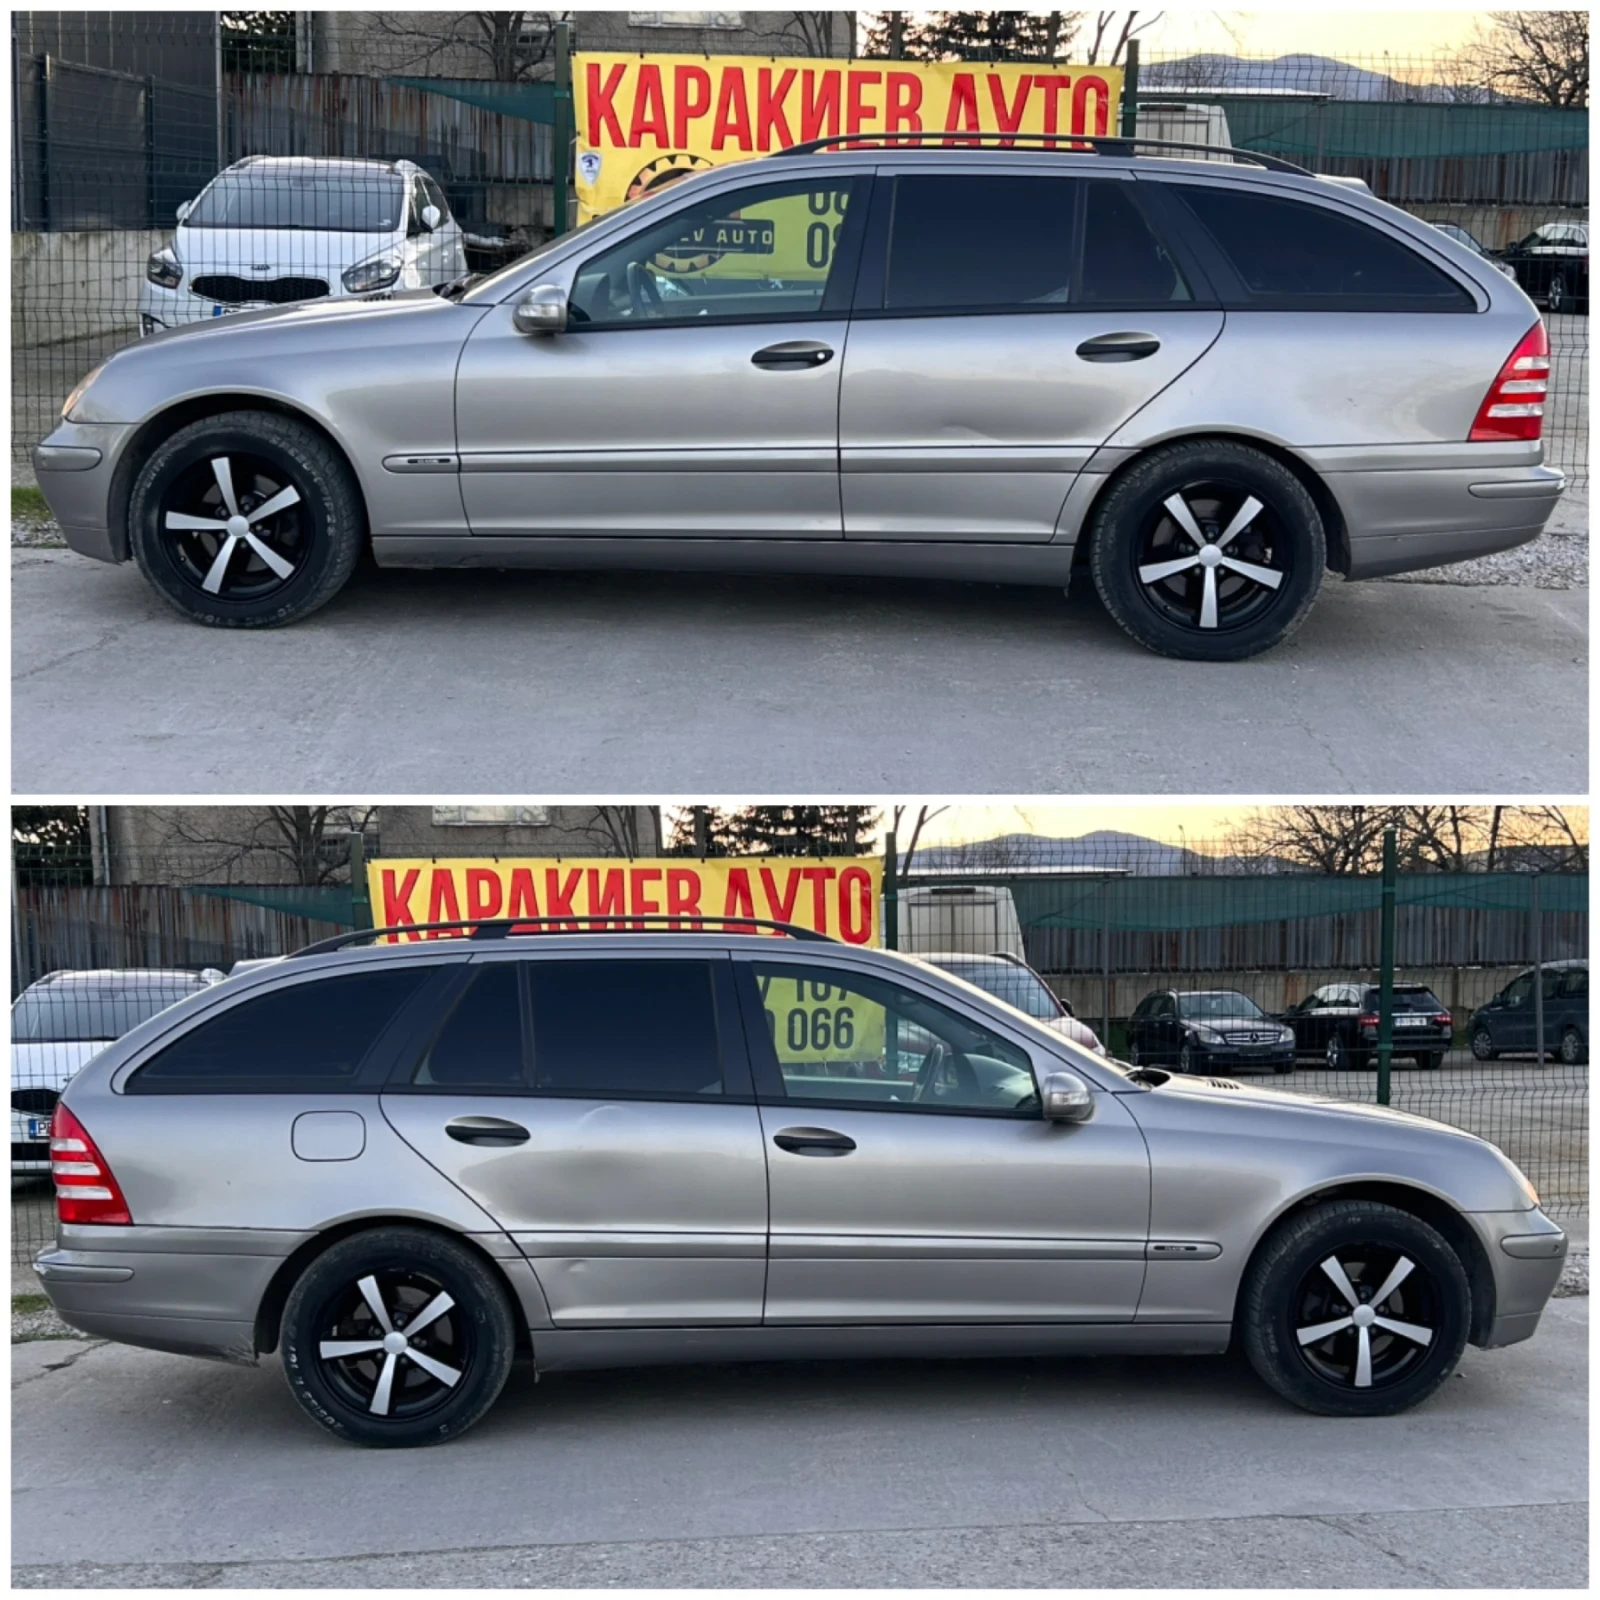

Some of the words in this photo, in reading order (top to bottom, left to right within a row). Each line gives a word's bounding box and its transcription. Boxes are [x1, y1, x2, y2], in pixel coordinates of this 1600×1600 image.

[586, 62, 923, 152] КАРАКИЕВ
[716, 229, 774, 246] AUTO
[381, 867, 703, 944] КАРАКИЕВ
[787, 1006, 855, 1052] 066
